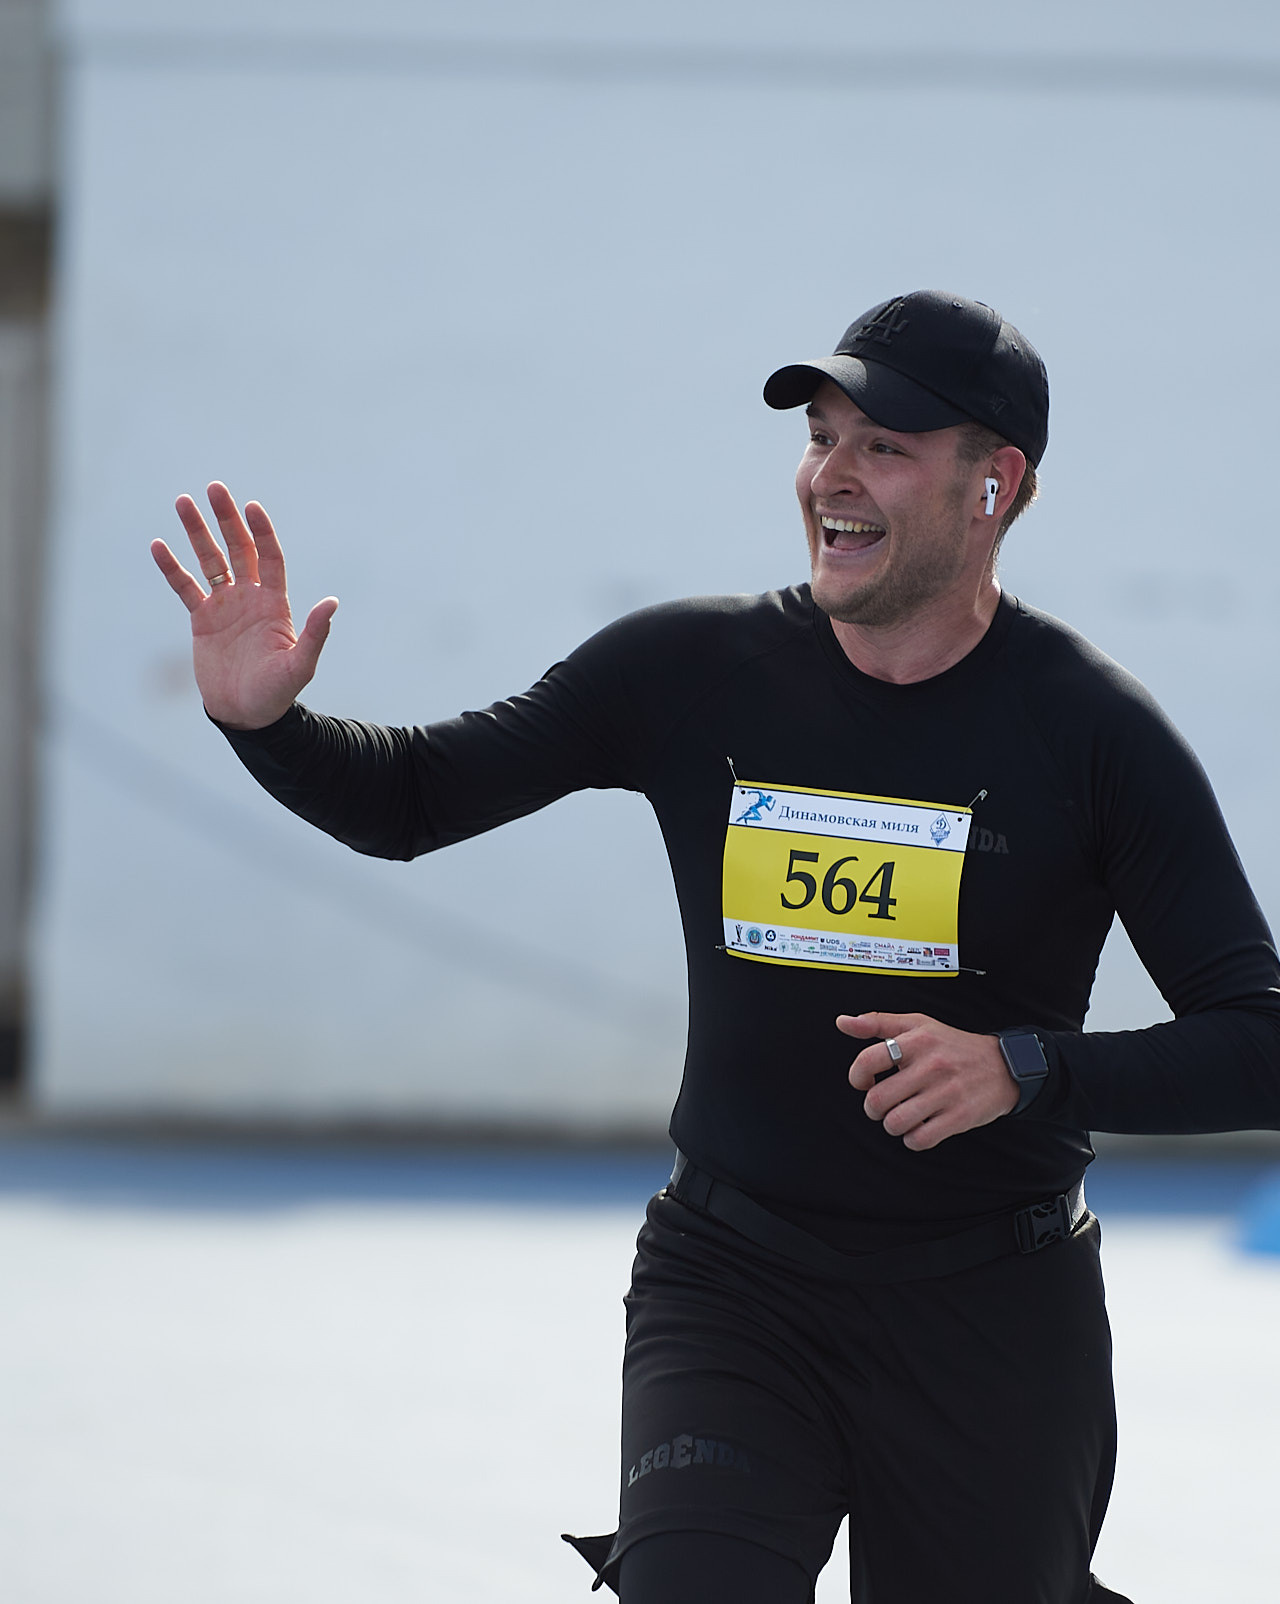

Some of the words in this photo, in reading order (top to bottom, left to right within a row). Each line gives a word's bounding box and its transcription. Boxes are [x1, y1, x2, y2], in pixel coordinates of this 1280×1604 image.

[778, 804, 877, 828] Динамовская
[880, 820, 919, 834] миля
[780, 849, 897, 921] 564
[627, 1433, 751, 1488] LEGENDA
